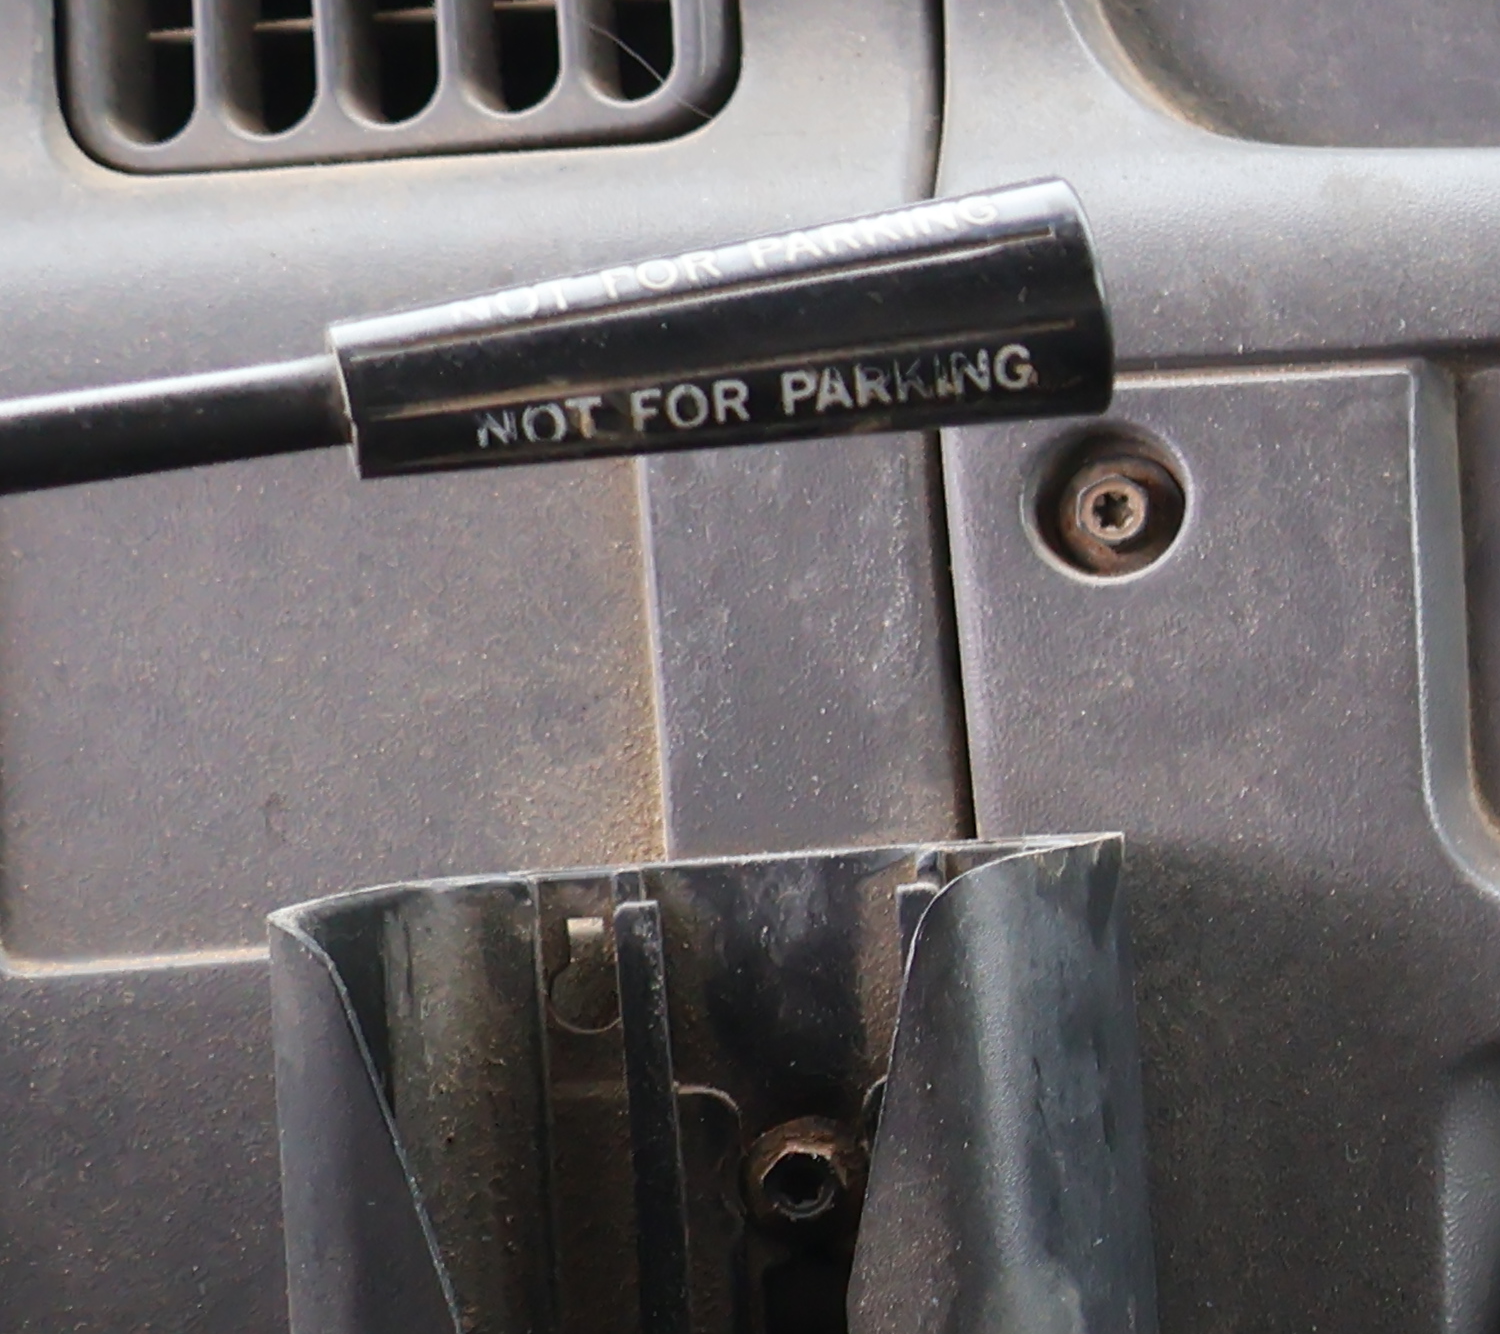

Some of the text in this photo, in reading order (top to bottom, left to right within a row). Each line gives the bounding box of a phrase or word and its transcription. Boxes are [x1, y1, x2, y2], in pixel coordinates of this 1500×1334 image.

[450, 195, 999, 324] NOT FOR PARKING
[475, 344, 1038, 449] NOT FOR PARKING
